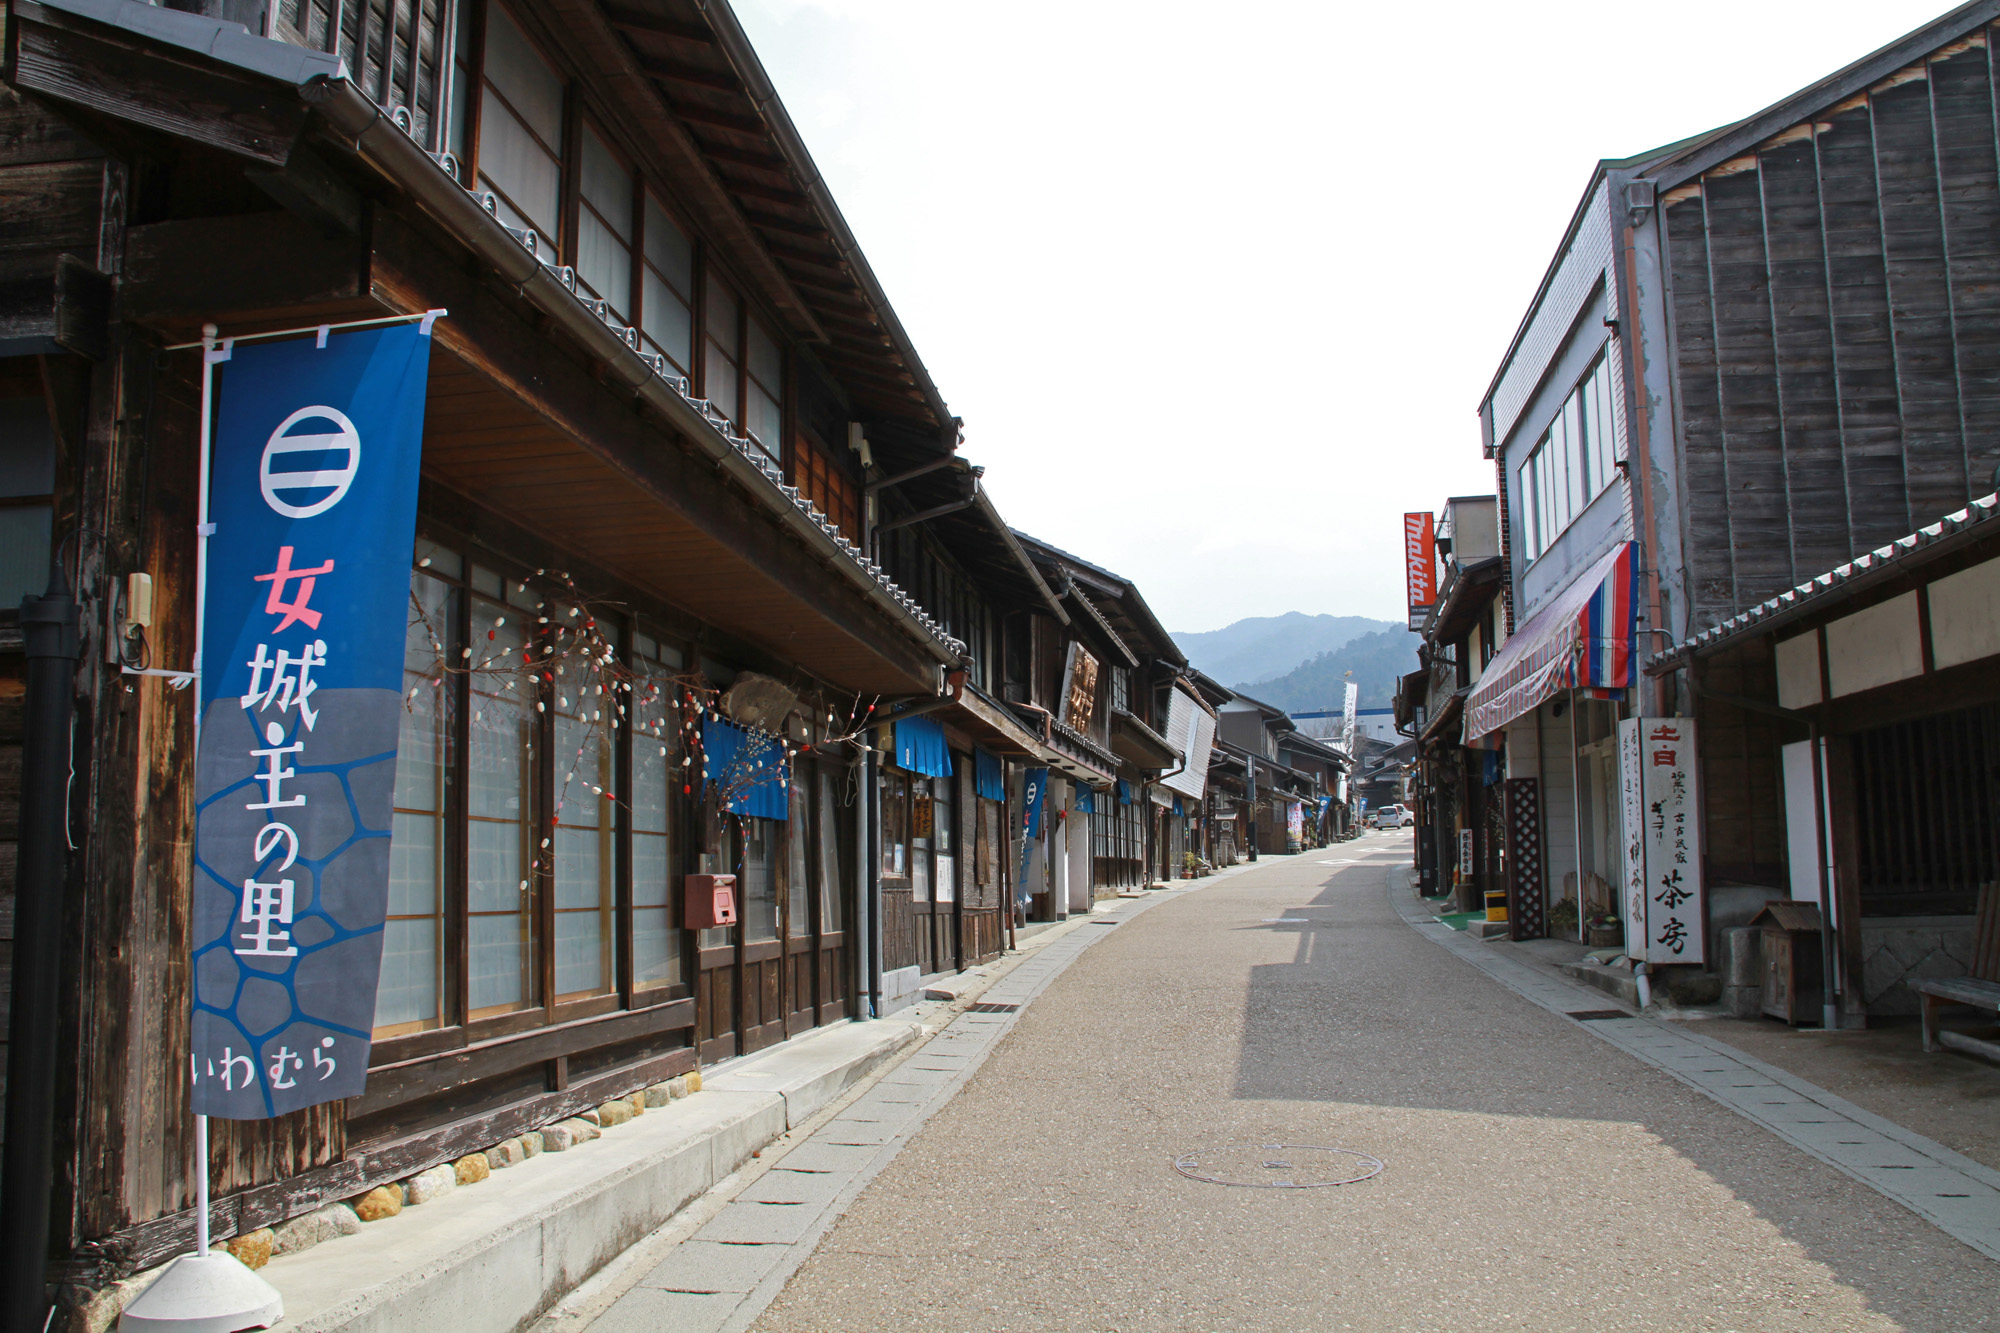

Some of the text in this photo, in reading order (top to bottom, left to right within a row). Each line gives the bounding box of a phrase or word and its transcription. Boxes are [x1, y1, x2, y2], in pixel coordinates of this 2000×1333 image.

[1406, 513, 1429, 606] makita
[234, 545, 335, 957] 女城主の里
[1654, 869, 1694, 954] 茶房
[190, 1036, 336, 1091] いわむら
